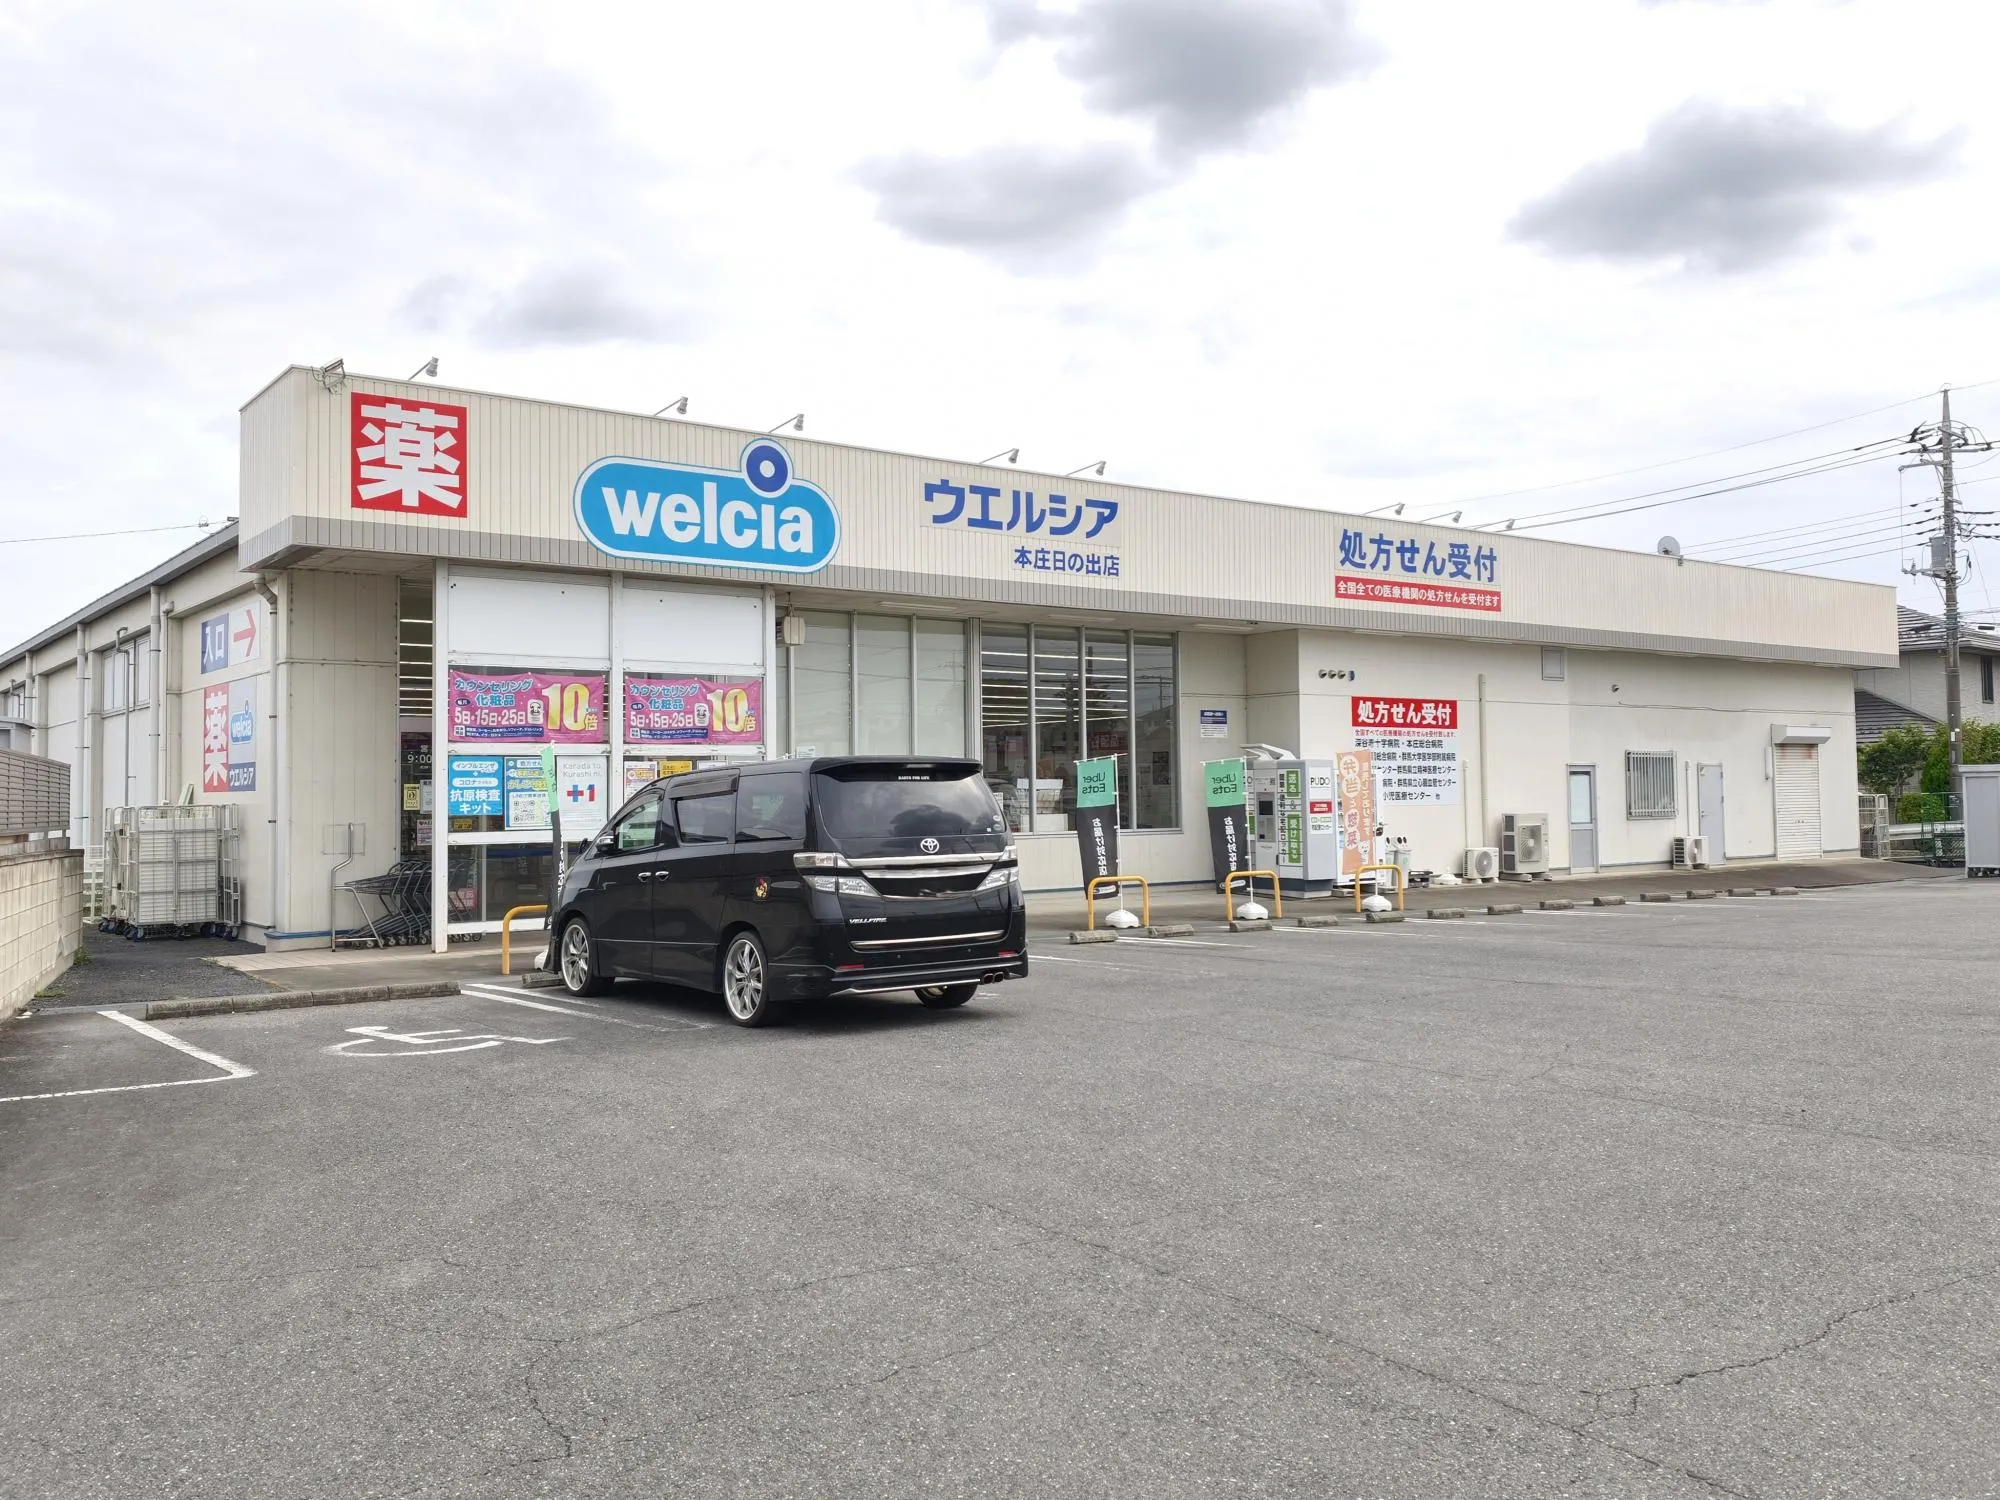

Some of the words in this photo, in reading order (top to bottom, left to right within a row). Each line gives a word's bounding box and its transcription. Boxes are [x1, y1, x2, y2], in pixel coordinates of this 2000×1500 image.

[356, 403, 463, 509] 薬
[601, 445, 813, 554] welcia
[924, 478, 1119, 539] ウエルシア
[1014, 545, 1120, 577] 本庄日の出店
[1339, 528, 1497, 583] 処方せん受付
[1336, 580, 1500, 608] 全国全ての医療機関の処方せんを受付ます
[203, 623, 225, 665] 入口
[454, 678, 533, 693] カウンセリング
[630, 683, 700, 698] カウンセリング
[475, 693, 516, 708] 化粧品
[648, 698, 685, 711] 化粧品
[1357, 699, 1452, 726] 処方せん受付
[231, 703, 252, 738] welcia
[204, 691, 228, 786] 薬
[229, 767, 255, 787] ウエルシア
[1310, 777, 1331, 786] PUDO
[450, 789, 501, 803] 抗原検査
[459, 803, 492, 815] キット
